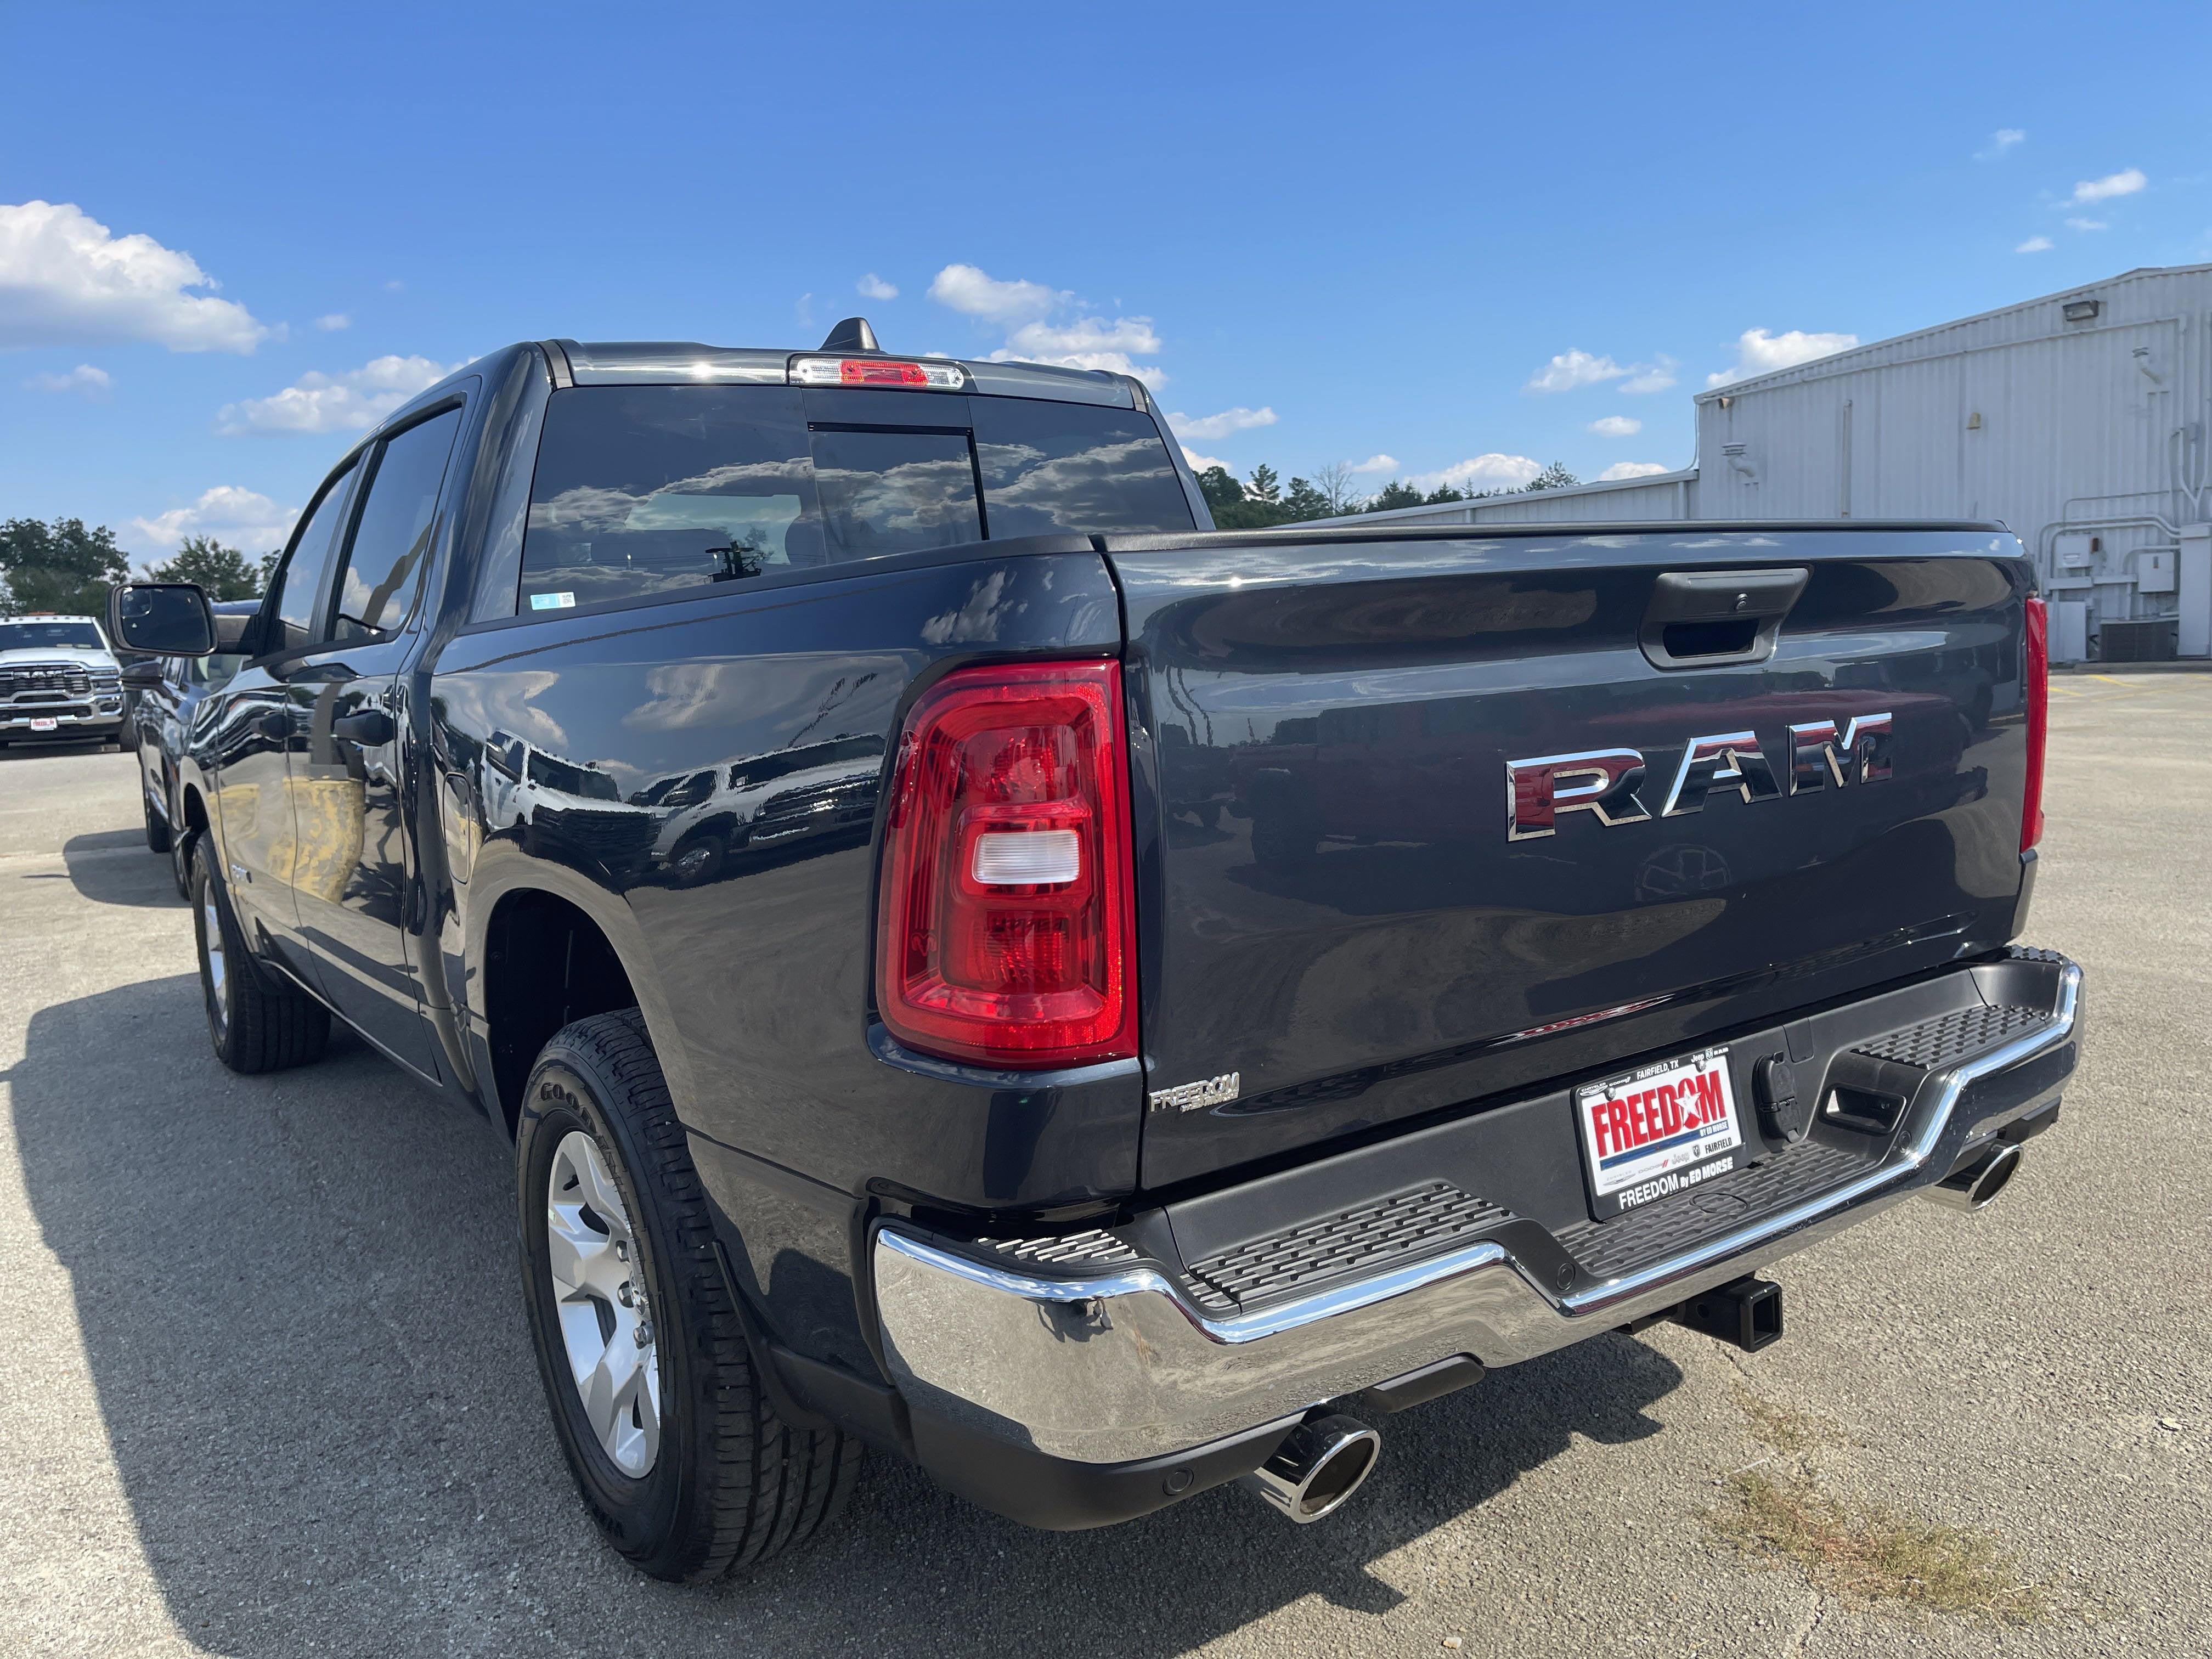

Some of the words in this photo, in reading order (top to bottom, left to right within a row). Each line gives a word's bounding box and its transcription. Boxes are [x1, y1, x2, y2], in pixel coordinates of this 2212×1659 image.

[1506, 712, 1892, 842] RAM
[1691, 1053, 1705, 1063] Jeep
[1713, 1047, 1729, 1056] RAM
[1637, 1063, 1669, 1080] FAIRFIELD,
[1670, 1059, 1679, 1069] TX
[1149, 1071, 1239, 1112] FREEDOM
[1591, 1070, 1727, 1158] FREEDOM
[1700, 1128, 1706, 1137] BY
[1706, 1126, 1713, 1135] ED
[1712, 1120, 1728, 1132] MORSE
[1705, 1137, 1733, 1154] FAIRFIELD
[1672, 1153, 1690, 1164] Jeep
[1619, 1173, 1679, 1209] FREEDOM
[1689, 1169, 1701, 1184] ED
[1702, 1156, 1733, 1180] MORSE
